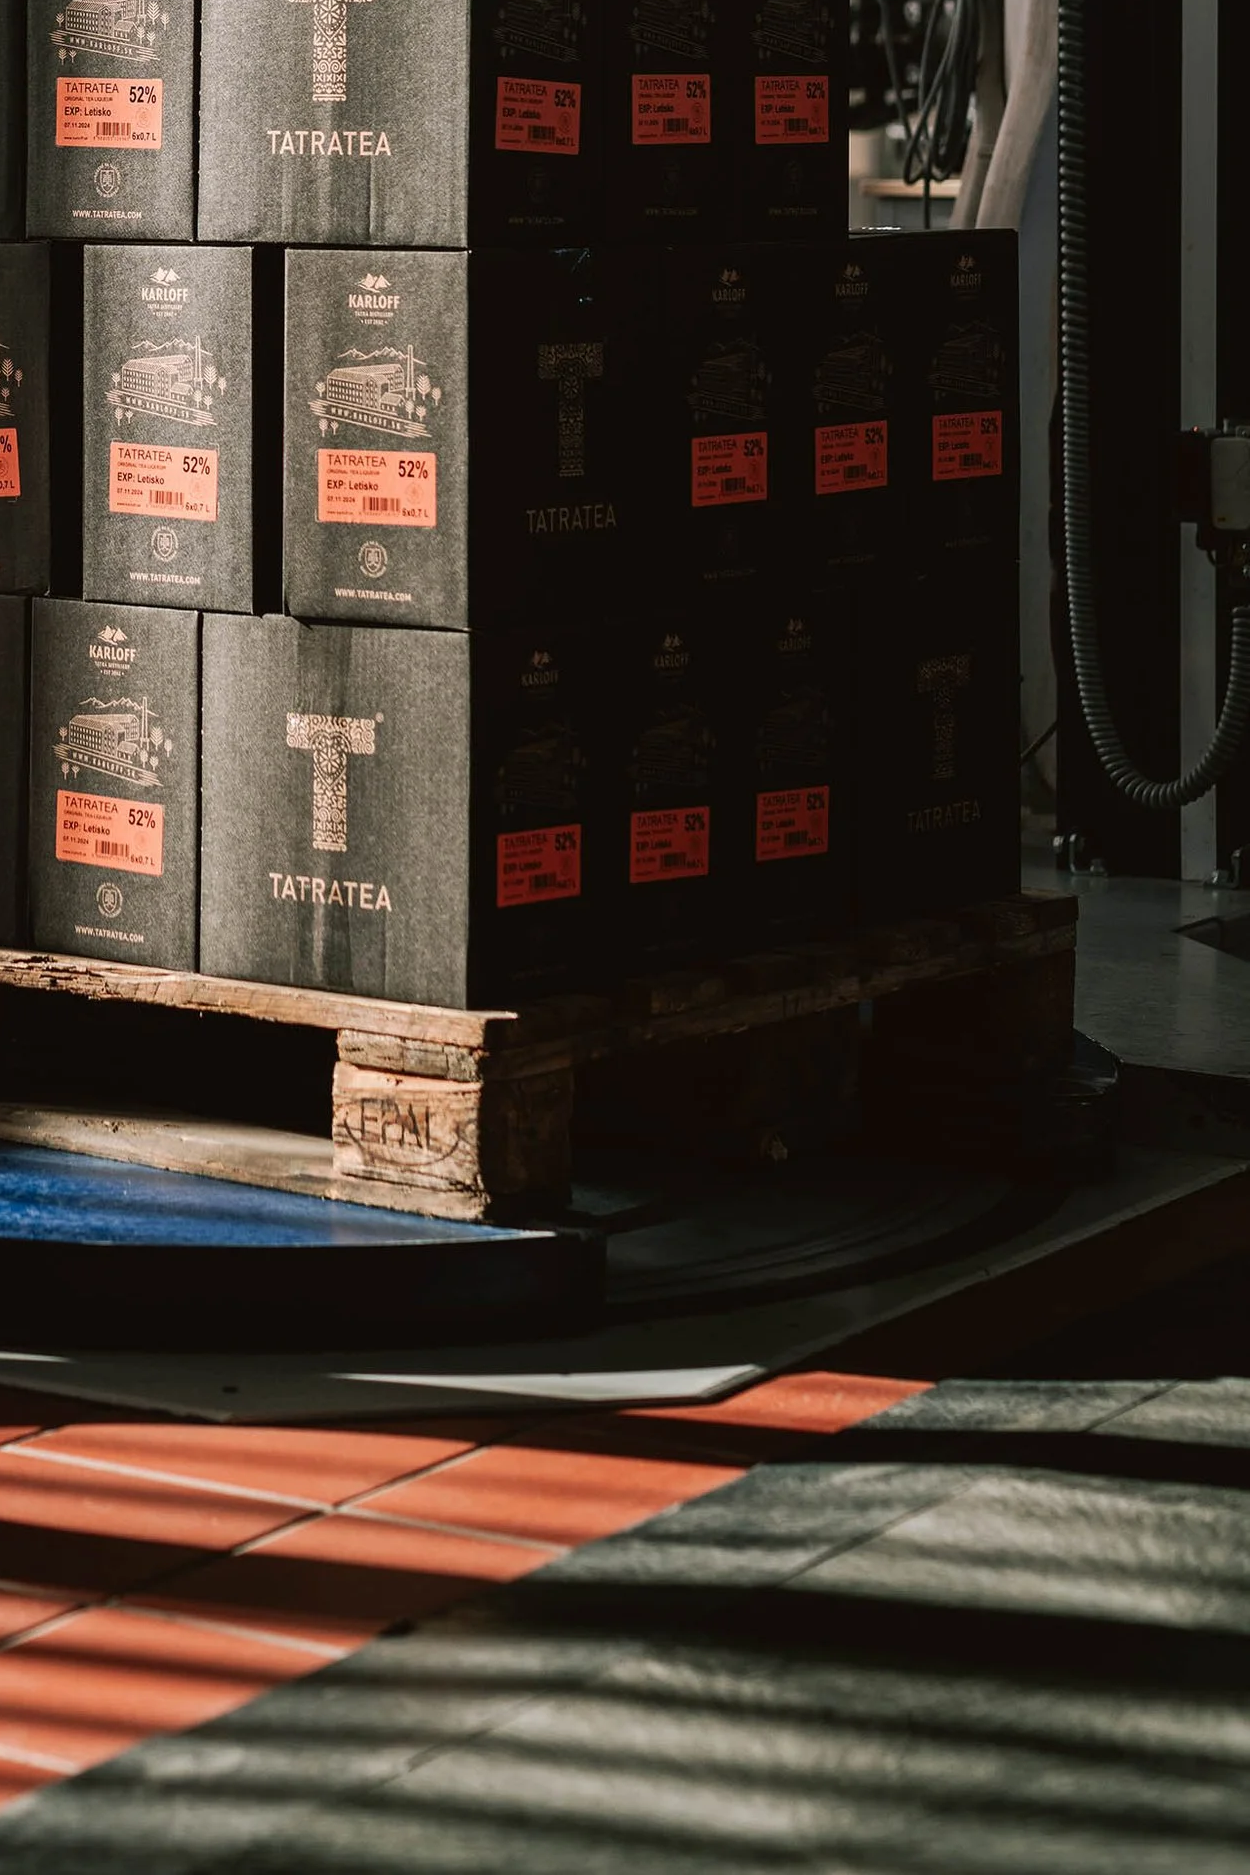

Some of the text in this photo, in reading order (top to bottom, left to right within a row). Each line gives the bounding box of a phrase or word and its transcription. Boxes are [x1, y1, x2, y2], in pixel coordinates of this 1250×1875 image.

[65, 82, 119, 93] TATRATEA
[129, 86, 157, 104] 52%
[686, 80, 706, 99] 52%
[806, 81, 825, 99] 52%
[554, 89, 576, 108] 52%
[64, 106, 112, 116] EXP: Letisko
[267, 129, 392, 156] TATRATEA
[72, 210, 142, 219] WWW.TATRATEA.COM
[141, 288, 189, 301] KARLOFF
[349, 294, 400, 309] KARLOFF
[864, 427, 883, 444] 52%
[118, 447, 172, 462] TATRATEA
[327, 454, 386, 467] TATRATEA
[182, 456, 210, 475] 52%
[398, 460, 428, 478] 52%
[117, 472, 165, 485] EXP: Letisko
[327, 479, 378, 491] EXP: Letisko
[526, 504, 617, 534] TATRATEA
[130, 572, 201, 585] WWW.TATRATEA.COM
[334, 588, 411, 601] WWW.TATRATEA.COM
[90, 644, 136, 662] KARLOFF
[64, 796, 118, 814] TATRATEA
[128, 808, 155, 828] 52%
[63, 820, 110, 835] EXP: Letisko
[269, 872, 392, 912] TATRATEA
[74, 925, 144, 942] WWW.TATRATEA.COM
